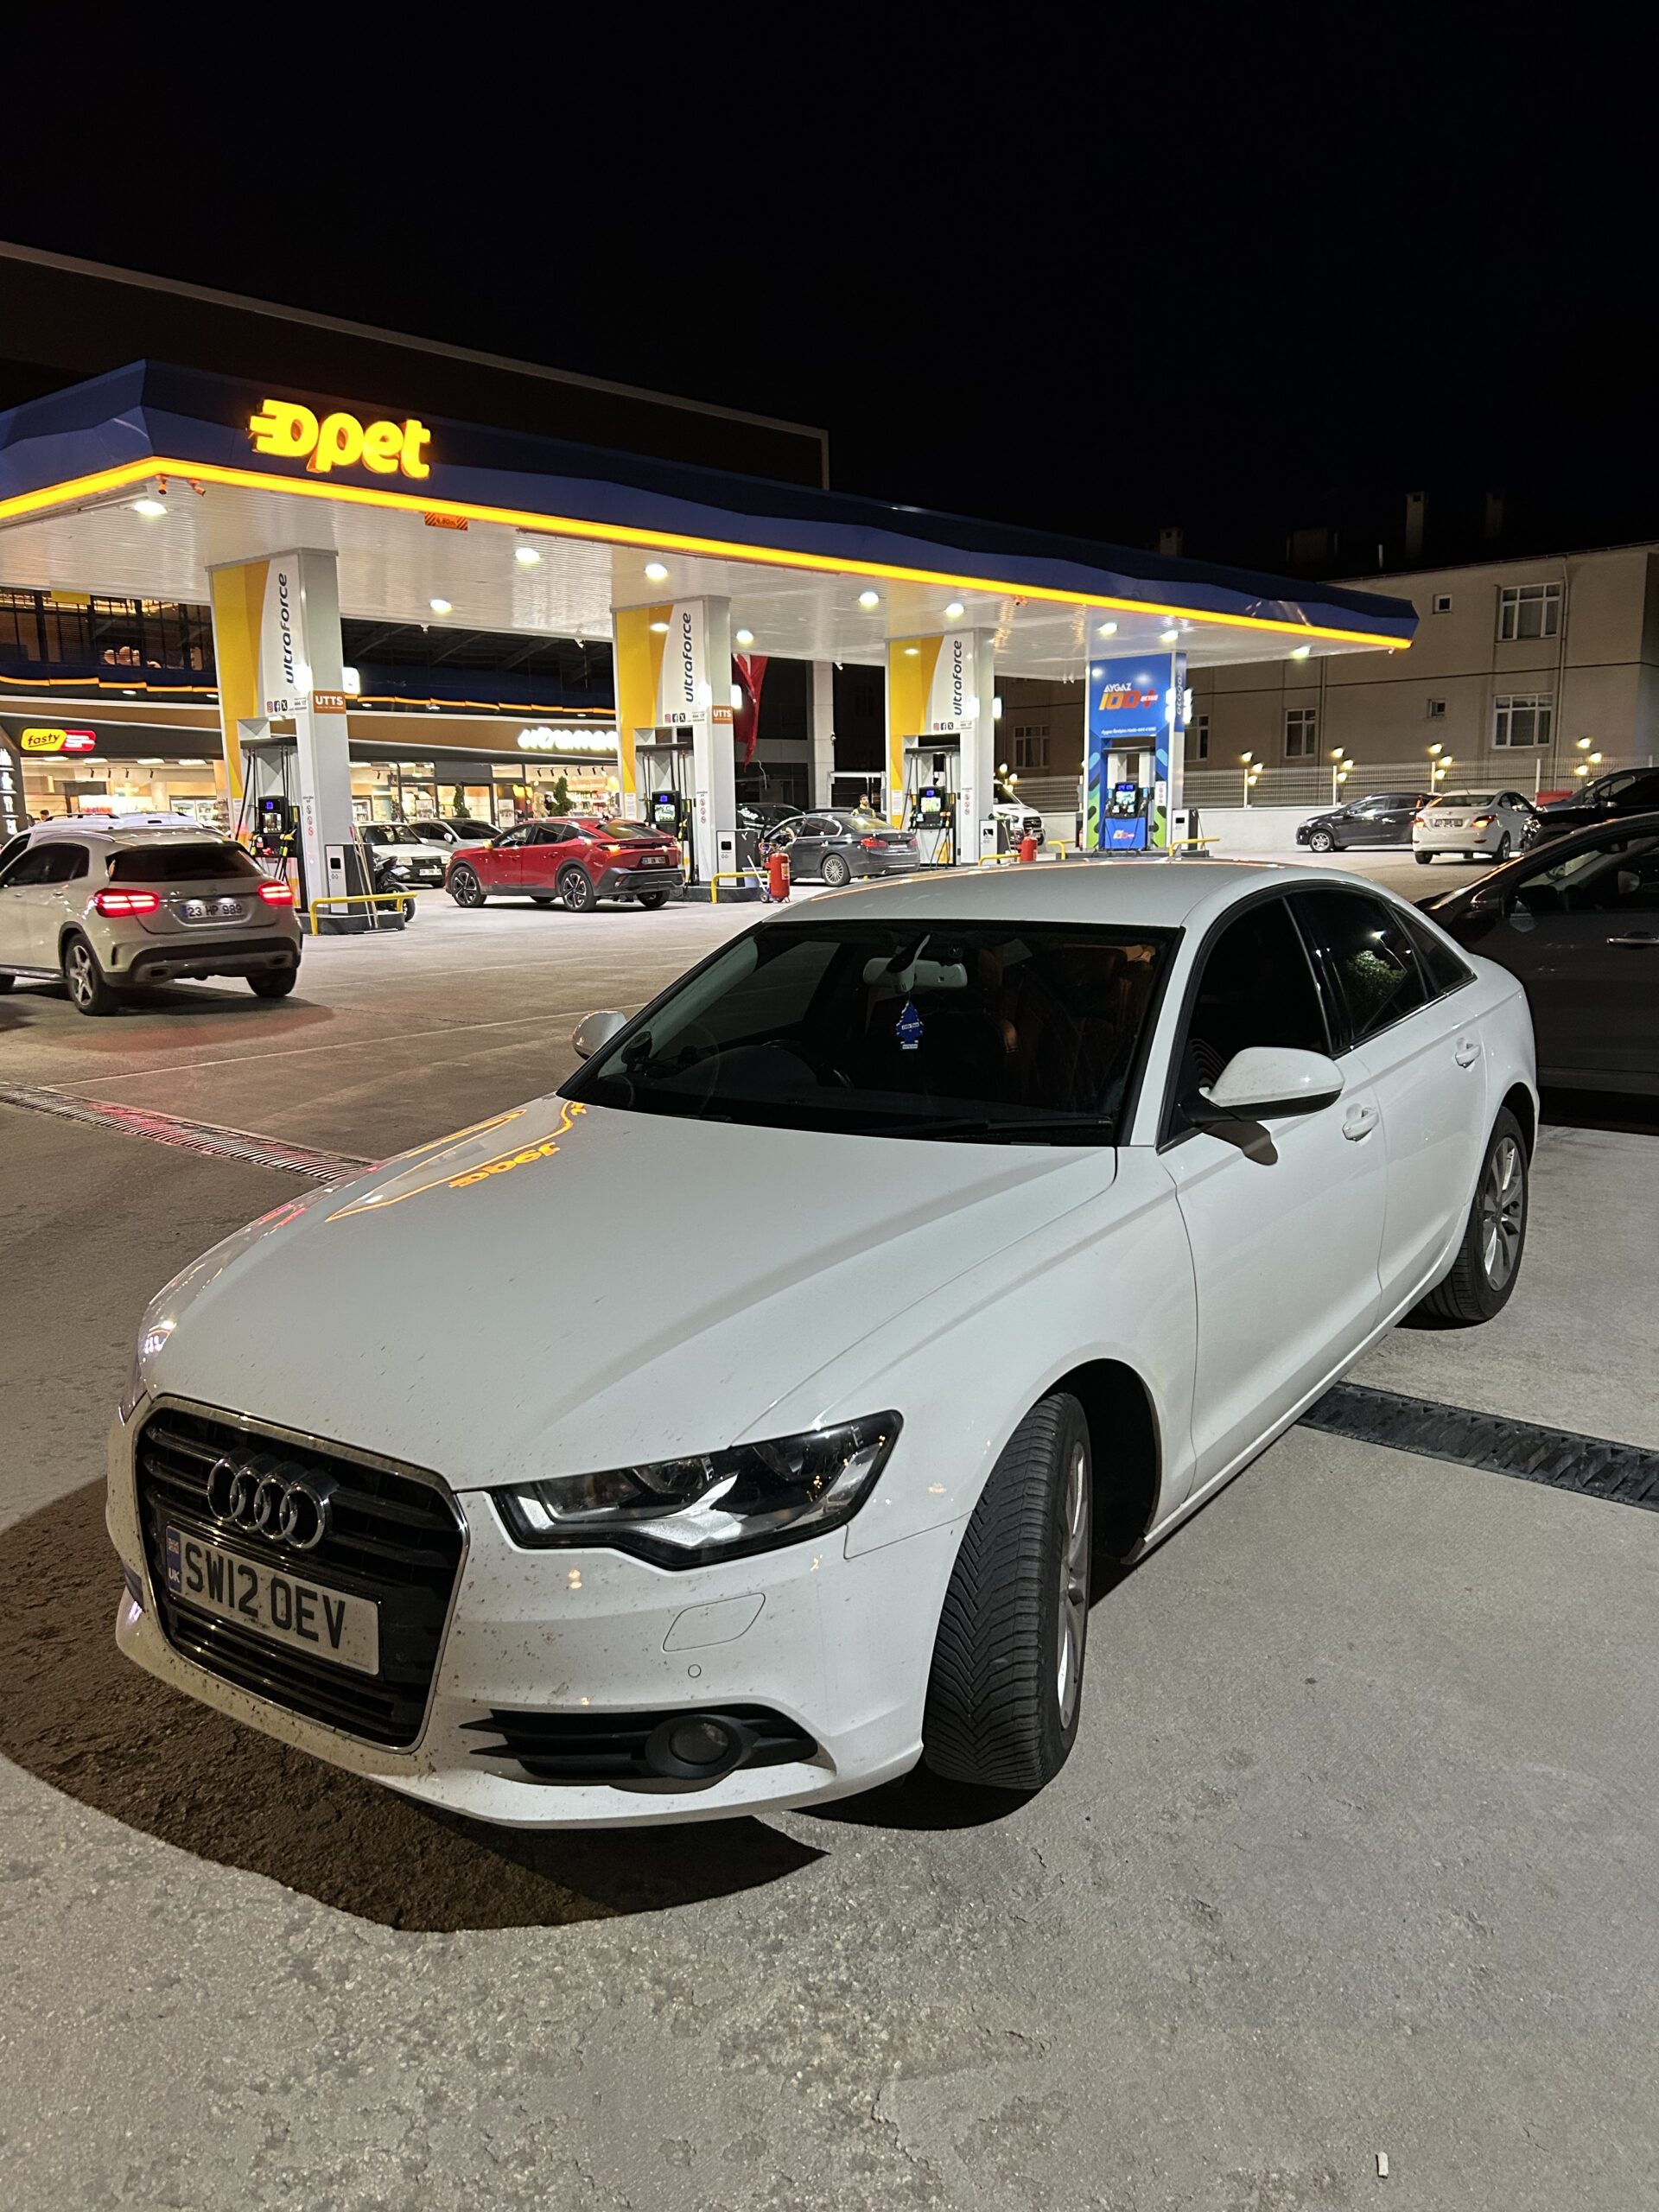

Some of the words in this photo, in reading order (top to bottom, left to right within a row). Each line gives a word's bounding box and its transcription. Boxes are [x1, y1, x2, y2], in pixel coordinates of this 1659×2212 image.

[1104, 683, 1132, 692] AYGAZ
[315, 696, 343, 705] UTTS
[714, 709, 731, 718] UTTS
[28, 734, 60, 747] fasty
[188, 906, 202, 917] 23
[168, 1567, 181, 1585] UK
[185, 1541, 258, 1618] SW12
